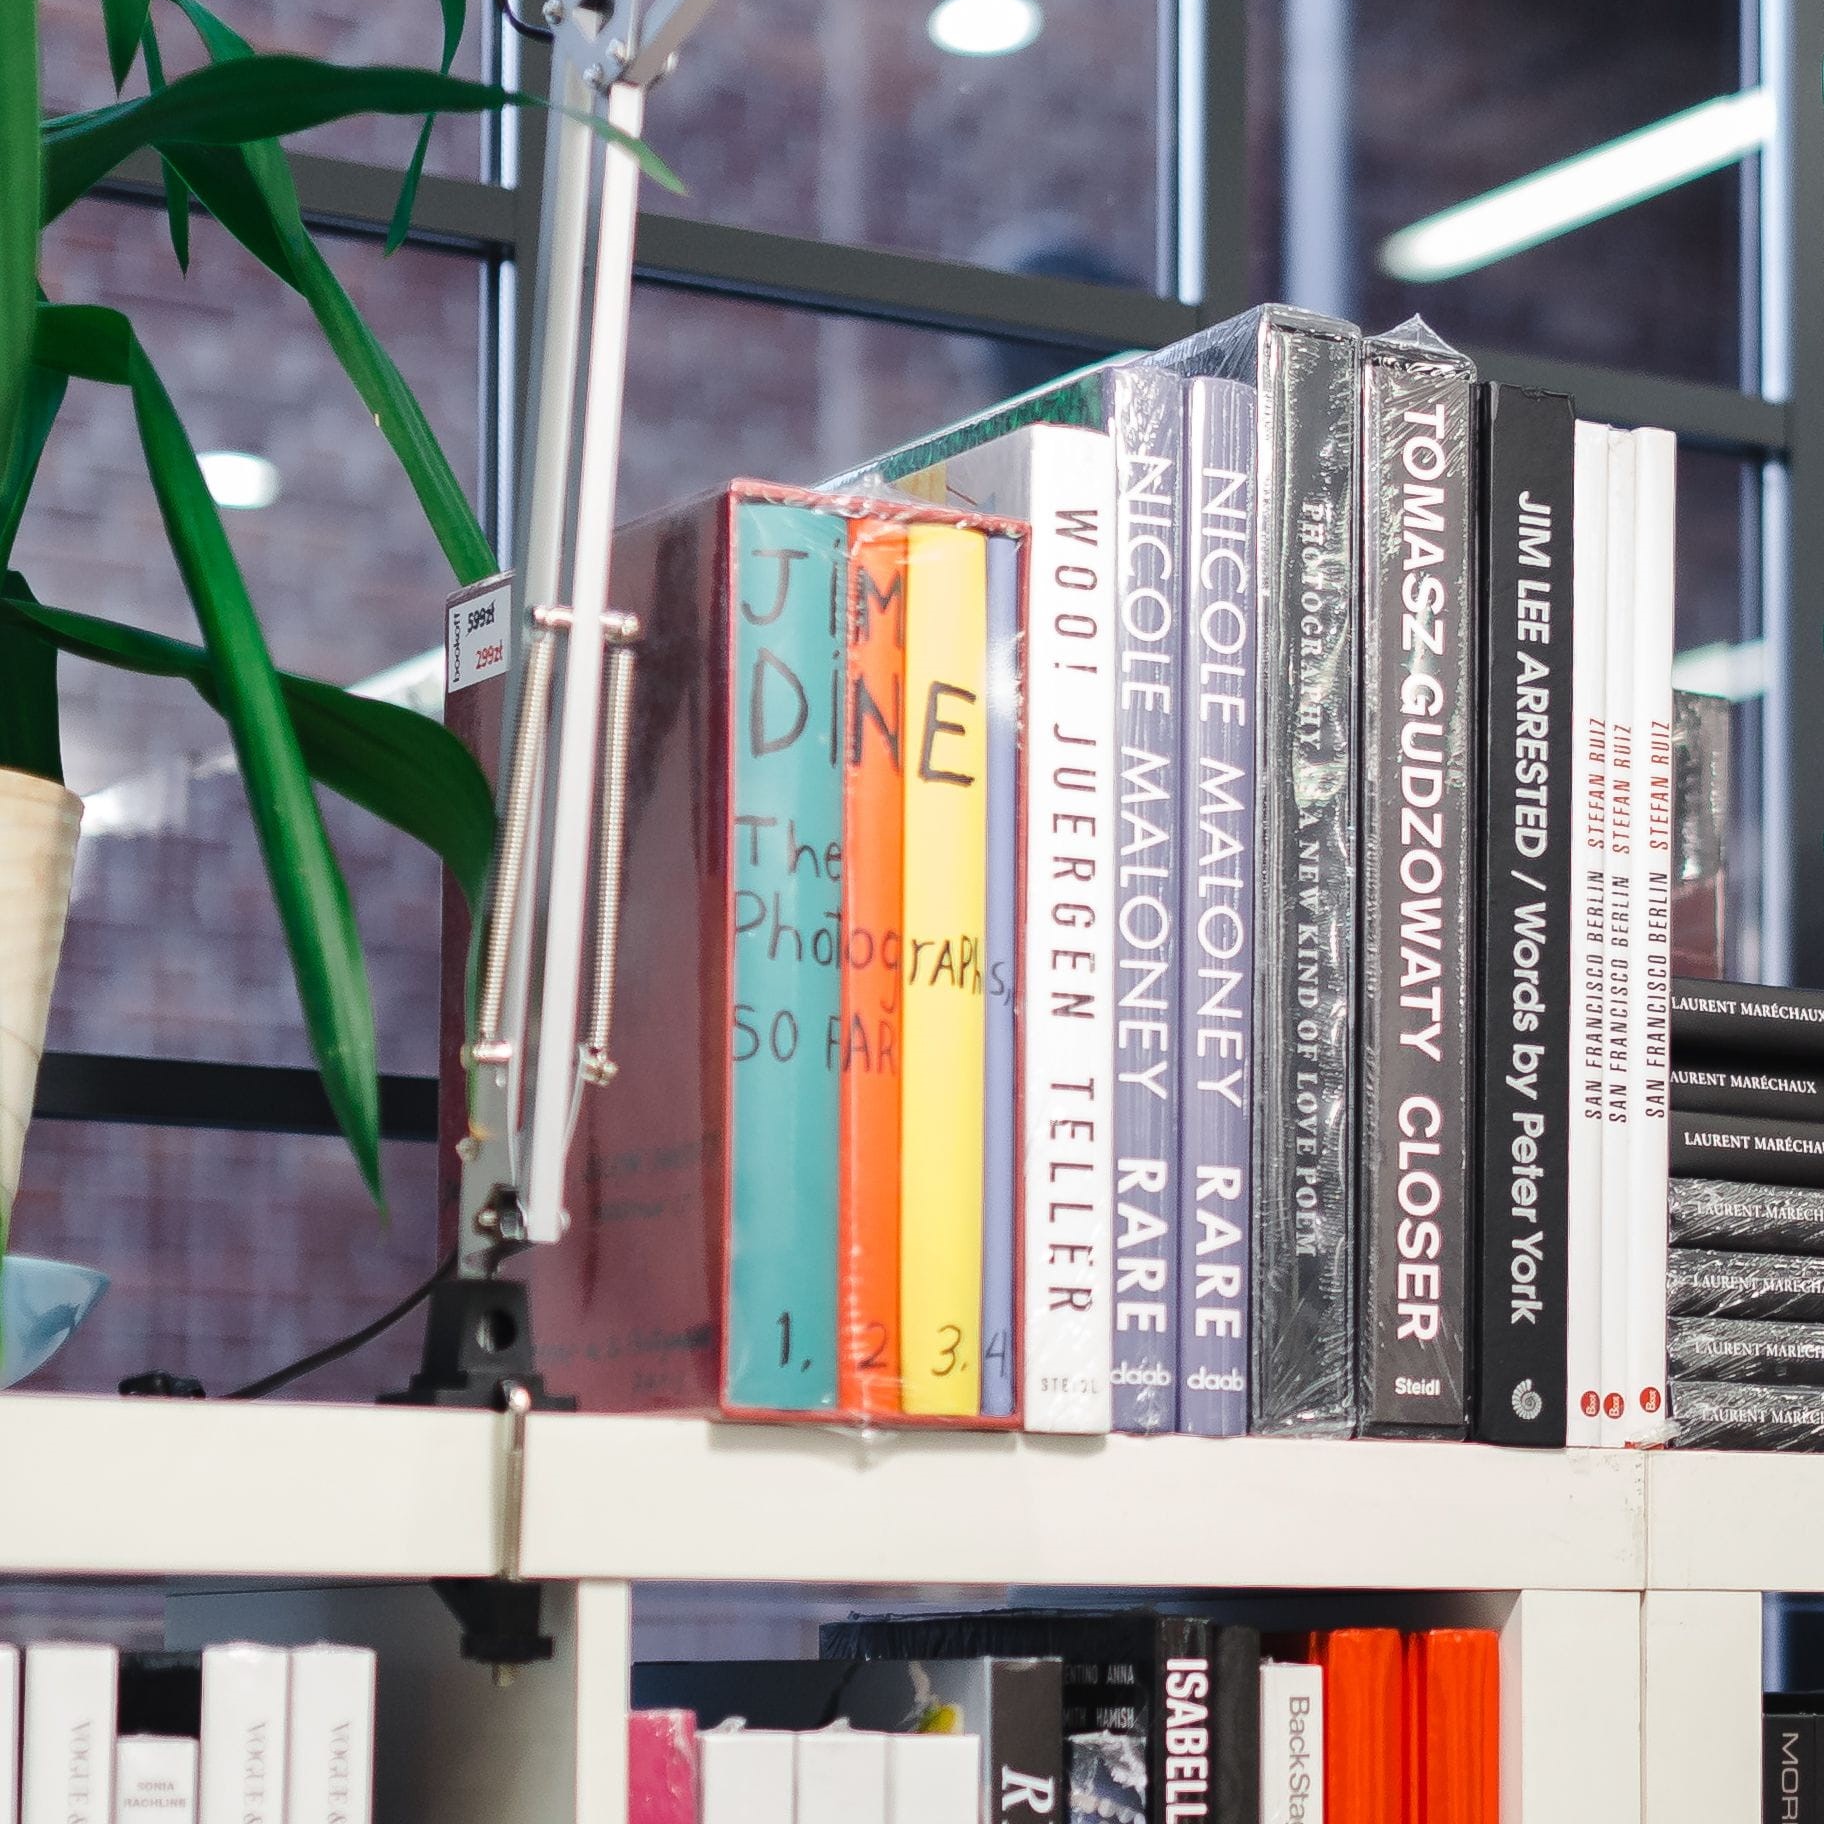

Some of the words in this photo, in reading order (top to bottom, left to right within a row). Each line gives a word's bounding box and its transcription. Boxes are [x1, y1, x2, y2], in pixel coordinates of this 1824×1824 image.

[1400, 403, 1445, 650] TOMASZ
[1515, 490, 1550, 566] JIM
[1053, 507, 1098, 674] WOO!
[1121, 452, 1172, 713] NICOLE
[1515, 580, 1549, 642] LEE
[1512, 652, 1548, 858] ARRESTED
[1613, 724, 1631, 768] RUIZ
[735, 816, 841, 884] The
[1051, 724, 1096, 1021] JUERGEN
[1396, 674, 1443, 1060] GUDZOWATY
[1612, 786, 1630, 855] STEFAN
[1118, 747, 1170, 1096] MALONEY
[1611, 876, 1630, 946] BERLIN
[1511, 903, 1547, 1031] Words
[1610, 959, 1628, 1072] FRANCISCO
[1671, 996, 1735, 1017] LAURENT
[732, 1011, 797, 1062] SO
[825, 1015, 899, 1074] FAR
[1502, 1043, 1547, 1097] by
[1609, 1085, 1626, 1124] SAN
[1048, 1078, 1094, 1315] TELLER
[1507, 1113, 1547, 1217] Peter
[1115, 1157, 1165, 1333] RARE
[1396, 1097, 1439, 1342] CLOSER
[1507, 1223, 1546, 1327] York
